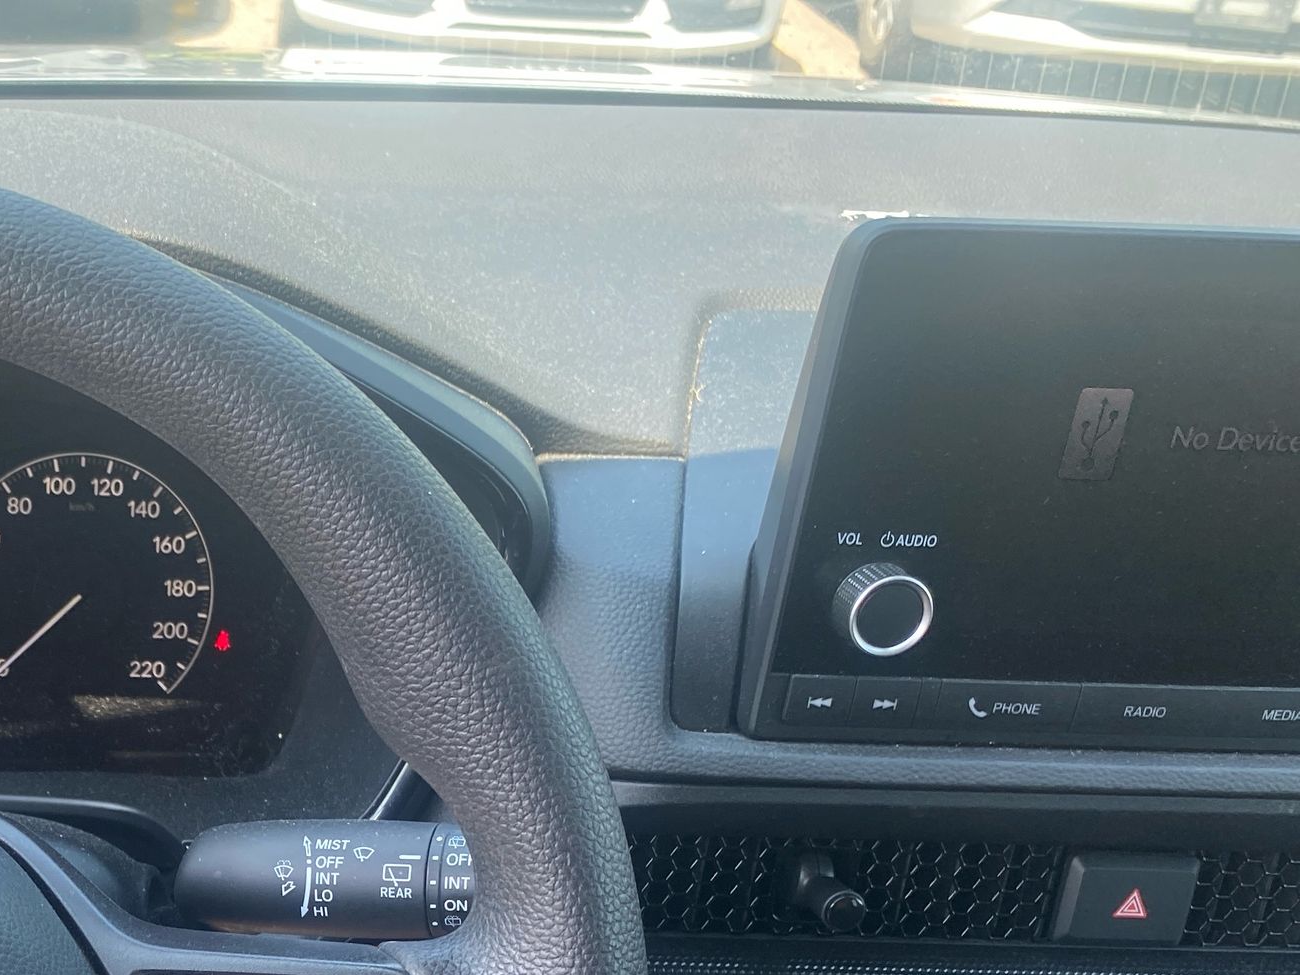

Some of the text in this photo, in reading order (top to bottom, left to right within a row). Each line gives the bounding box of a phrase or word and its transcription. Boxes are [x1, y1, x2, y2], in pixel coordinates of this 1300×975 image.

[1170, 425, 1209, 450] No
[43, 477, 75, 496] 100
[91, 479, 124, 497] 120
[7, 497, 32, 515] 80
[127, 500, 160, 518] 140
[153, 536, 185, 554] 160
[837, 532, 863, 546] VOL
[895, 534, 938, 548] AUDIO
[164, 580, 196, 597] 180
[152, 622, 188, 640] 200
[129, 661, 165, 679] 220
[992, 702, 1041, 716] PHONE
[1123, 705, 1167, 719] RADIO
[315, 839, 350, 851] MIST
[315, 856, 344, 869] OFF
[315, 872, 340, 886] INT
[444, 876, 471, 890] INT
[314, 889, 333, 902] LO
[380, 886, 412, 899] REAR
[313, 906, 328, 917] HI
[444, 899, 468, 912] ON
